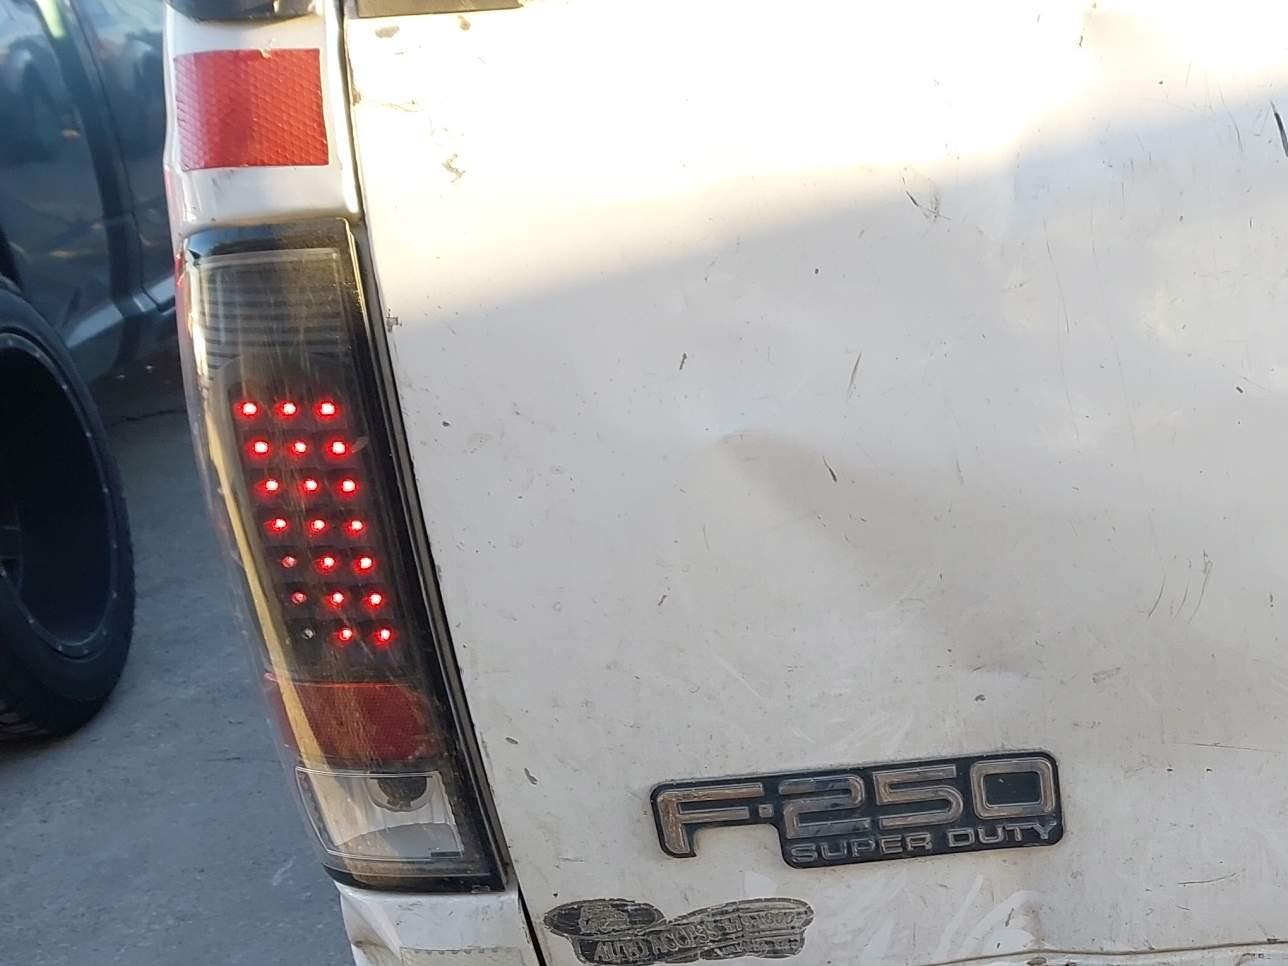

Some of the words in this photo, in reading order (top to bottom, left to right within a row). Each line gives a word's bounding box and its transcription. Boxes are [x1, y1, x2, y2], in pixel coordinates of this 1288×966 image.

[656, 756, 1056, 856] F-250
[790, 832, 933, 864] SUPER
[948, 822, 1058, 849] DUTY
